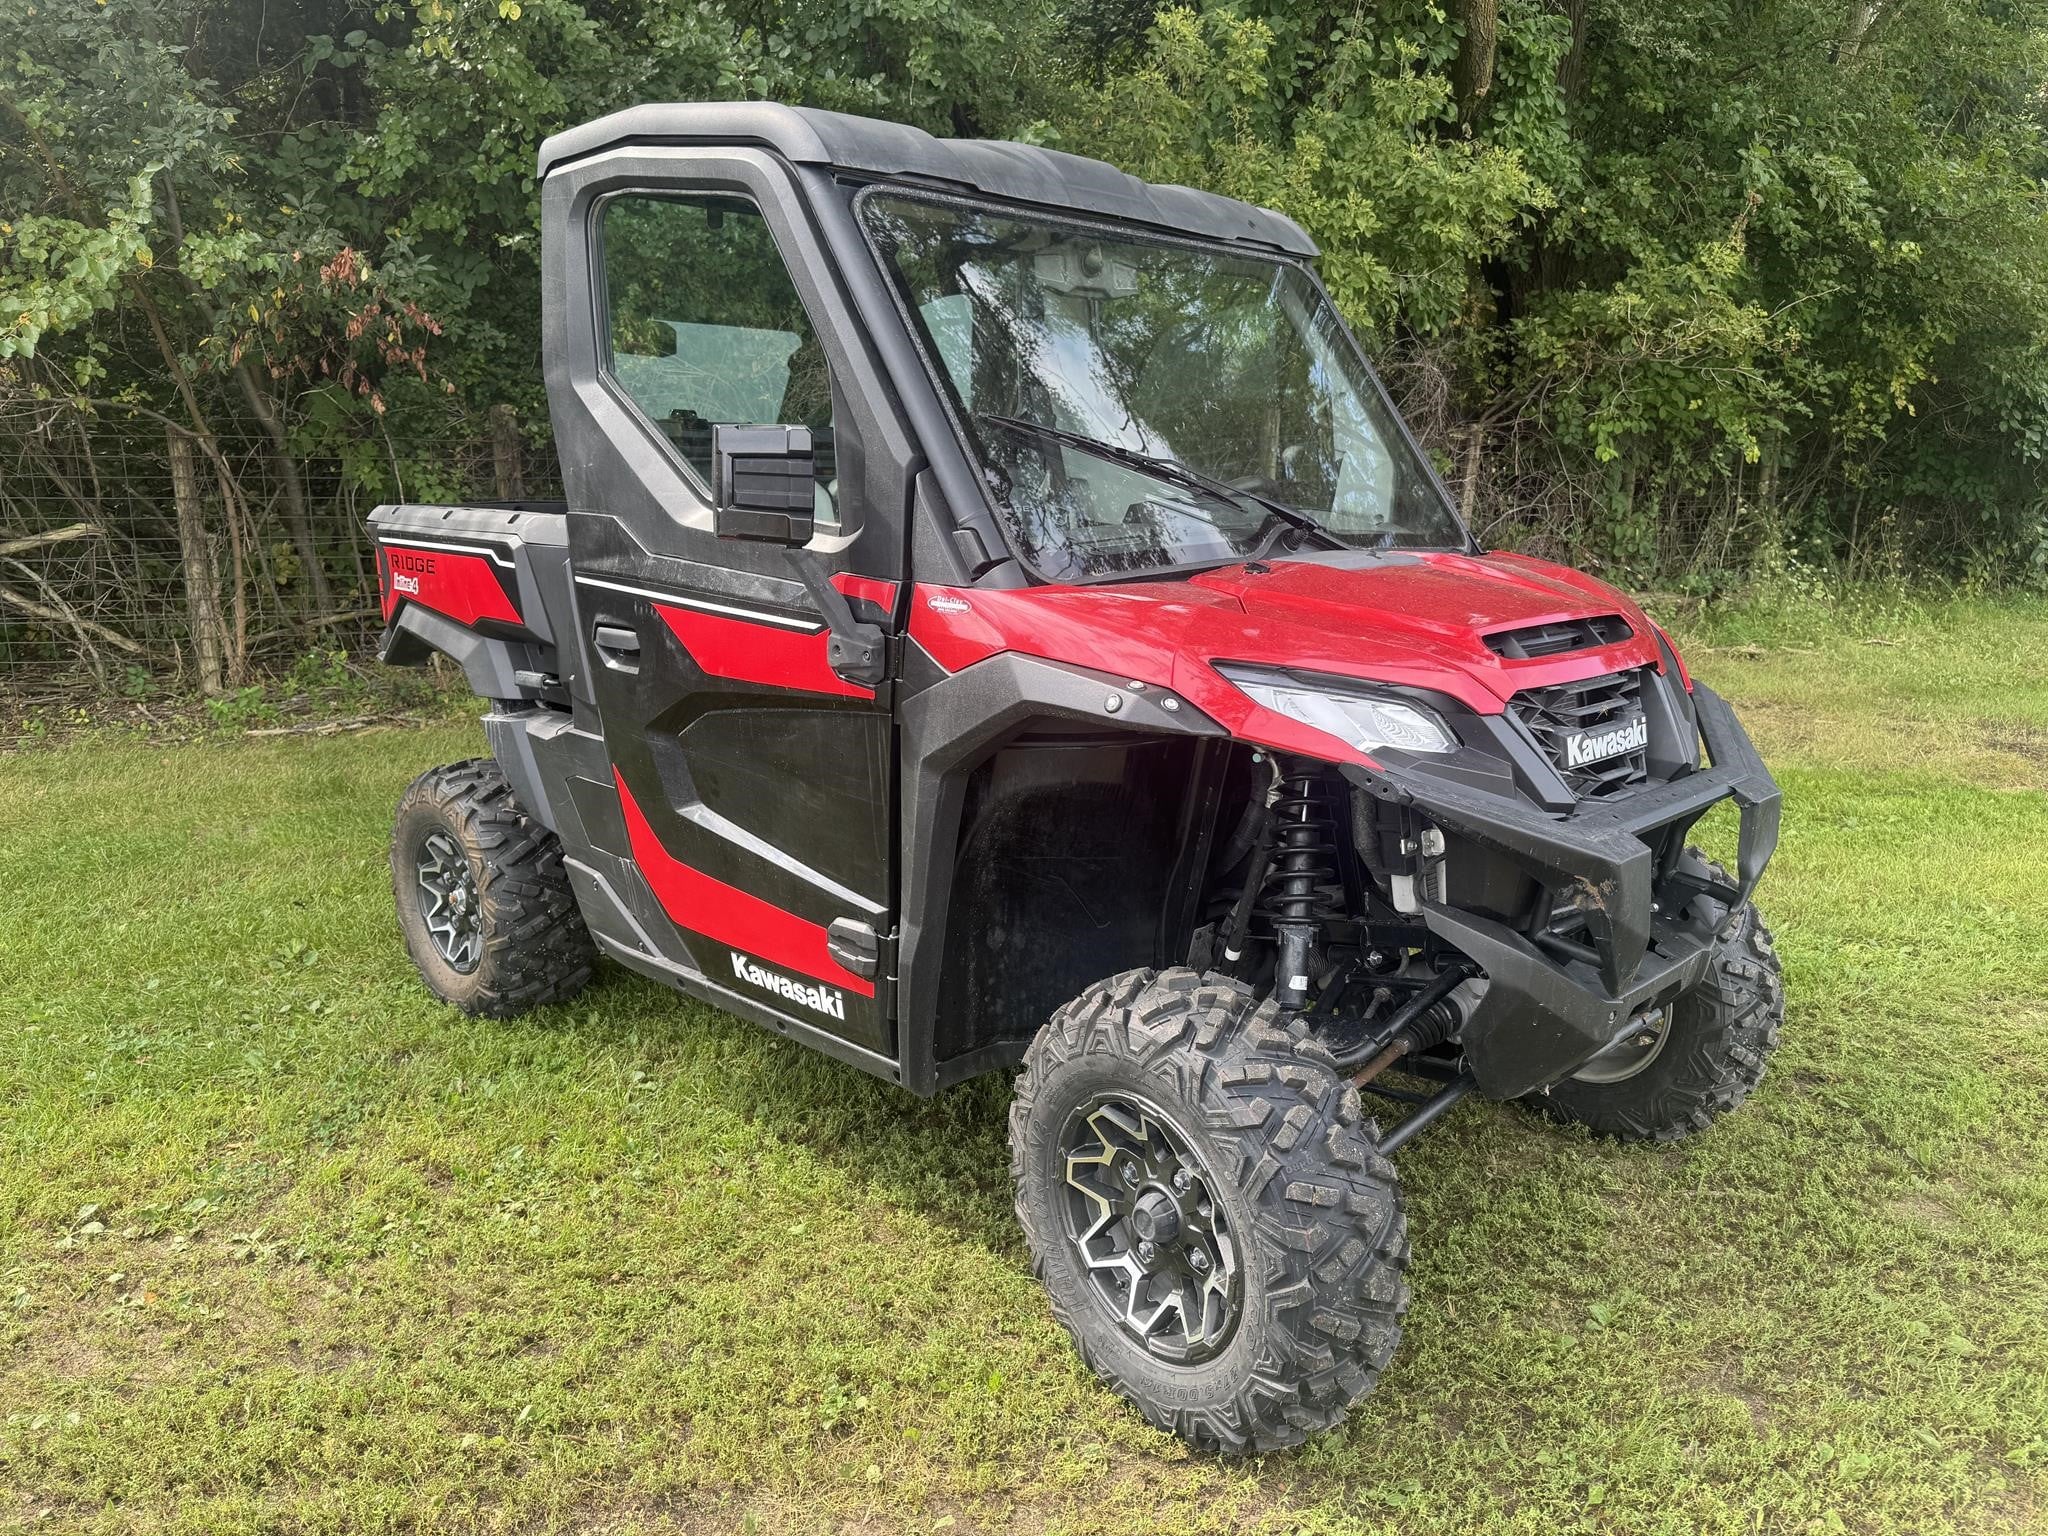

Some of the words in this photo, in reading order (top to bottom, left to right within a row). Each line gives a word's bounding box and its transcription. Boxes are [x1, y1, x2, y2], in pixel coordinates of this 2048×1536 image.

[391, 554, 435, 574] RIDGE
[1567, 716, 1647, 766] Kawasaki
[730, 951, 845, 1020] Kawasaki
